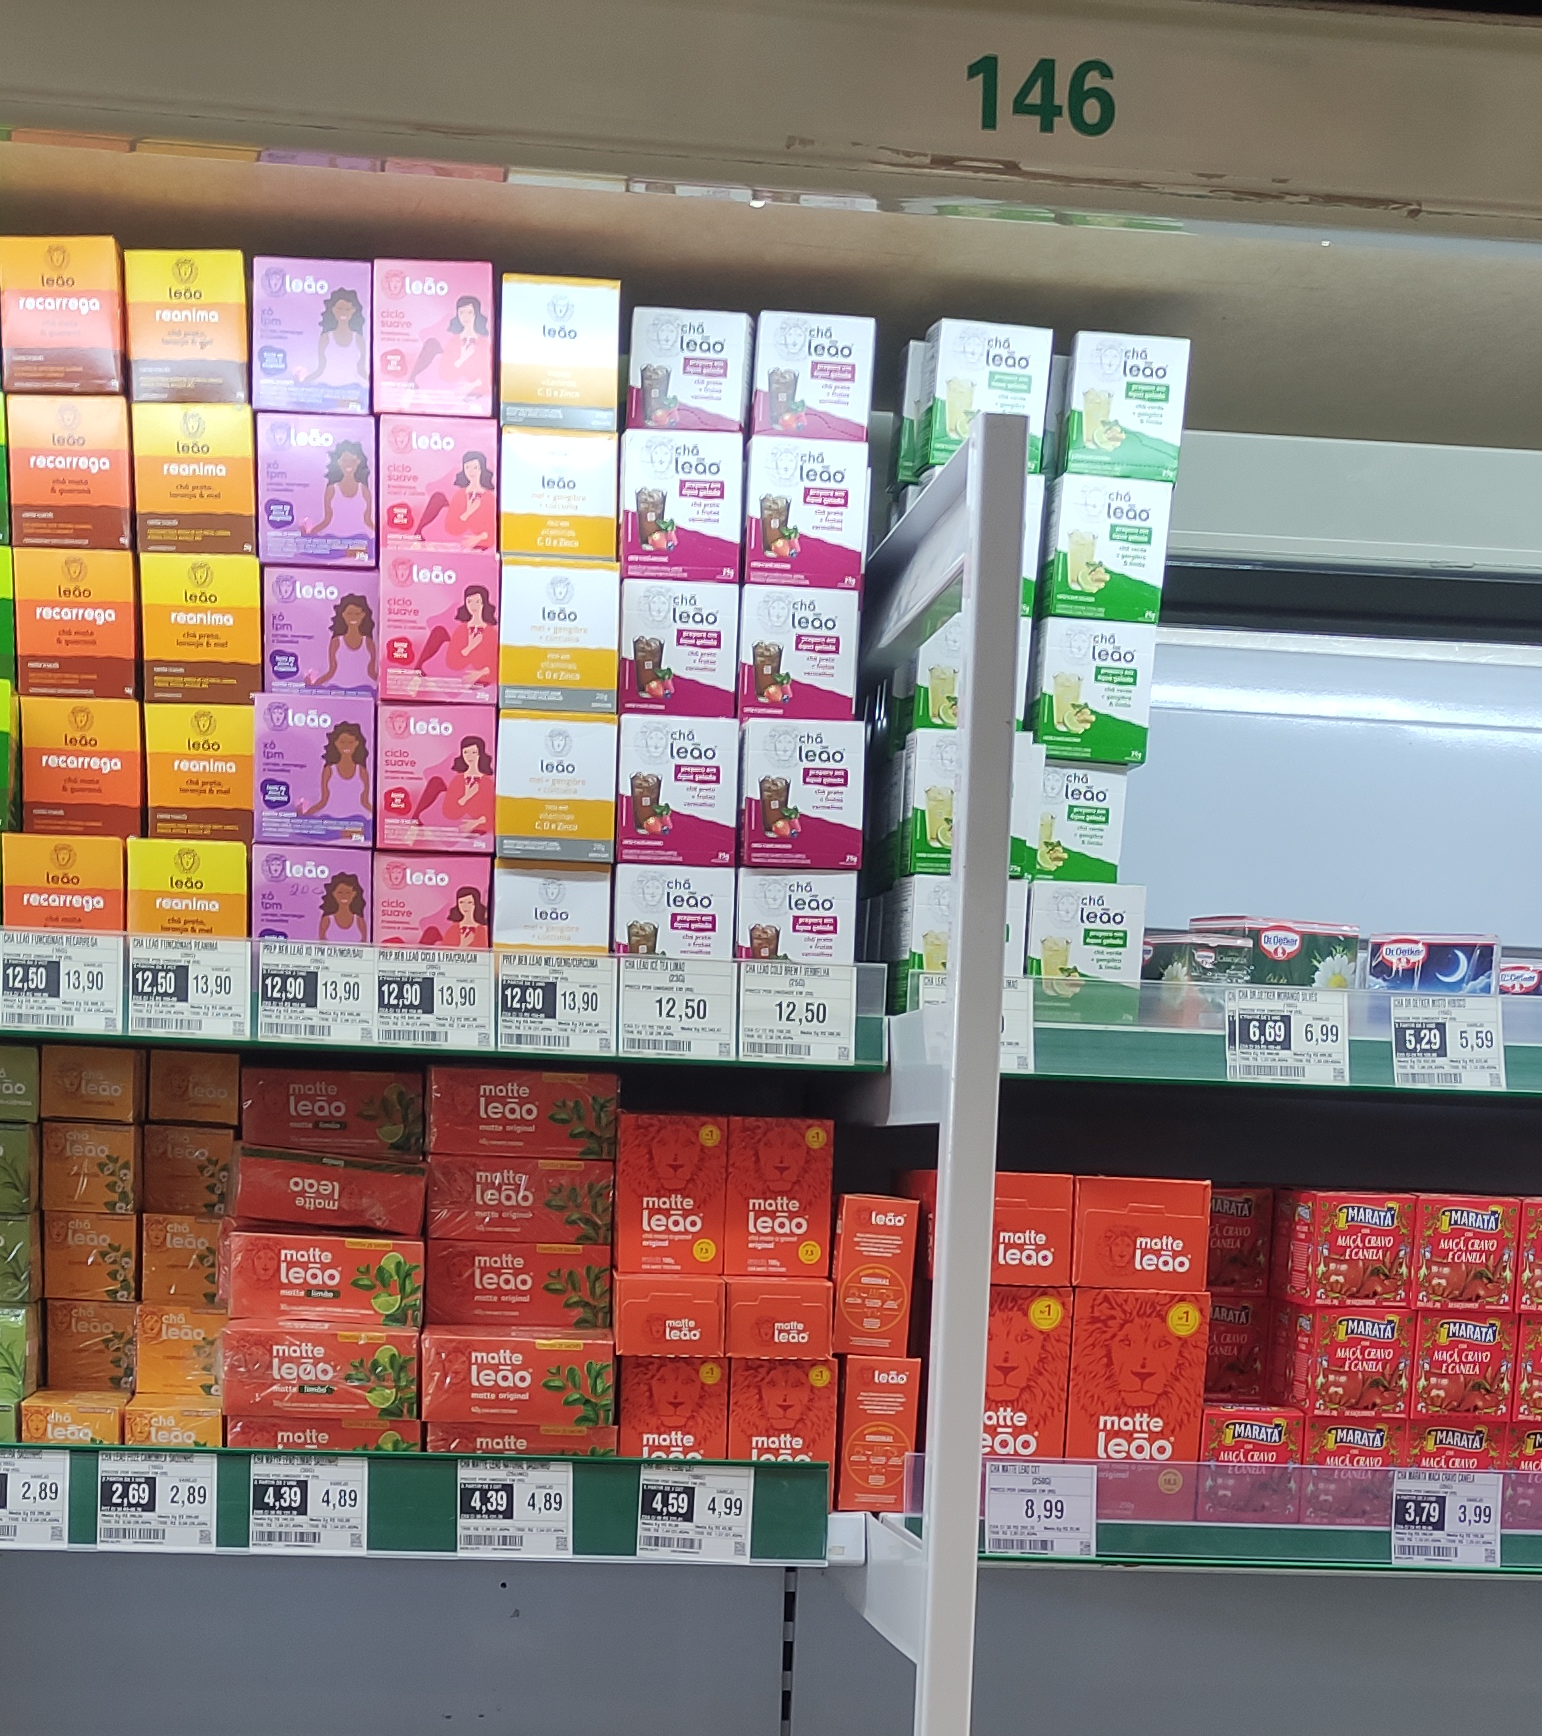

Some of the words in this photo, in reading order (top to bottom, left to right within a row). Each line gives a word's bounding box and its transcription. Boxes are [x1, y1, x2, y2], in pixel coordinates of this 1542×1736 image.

[967, 54, 1116, 137] 146
[18, 295, 100, 315] recarrega
[155, 307, 218, 323] reanima
[287, 709, 331, 729] leão
[409, 717, 453, 737] leão
[670, 729, 695, 742] chá
[384, 748, 408, 758] ciclo
[670, 741, 717, 760] leão
[384, 758, 416, 768] suave
[655, 998, 708, 1022] 12,50
[1249, 1022, 1285, 1044] 6,69
[1304, 1024, 1339, 1046] 6,99
[280, 1246, 332, 1264] matte
[280, 1263, 339, 1286] leão
[1098, 1414, 1163, 1432] matte
[1097, 1432, 1173, 1460] leão
[111, 1482, 150, 1507] 2,69
[169, 1485, 207, 1507] 2,89
[263, 1485, 301, 1511] 4,39
[321, 1488, 358, 1511] 4,89
[651, 1492, 689, 1517] 4,59
[707, 1495, 743, 1518] 4,99
[1024, 1499, 1065, 1520] 8,99
[1405, 1501, 1440, 1524] 3,79
[1458, 1504, 1492, 1525] 3,99
